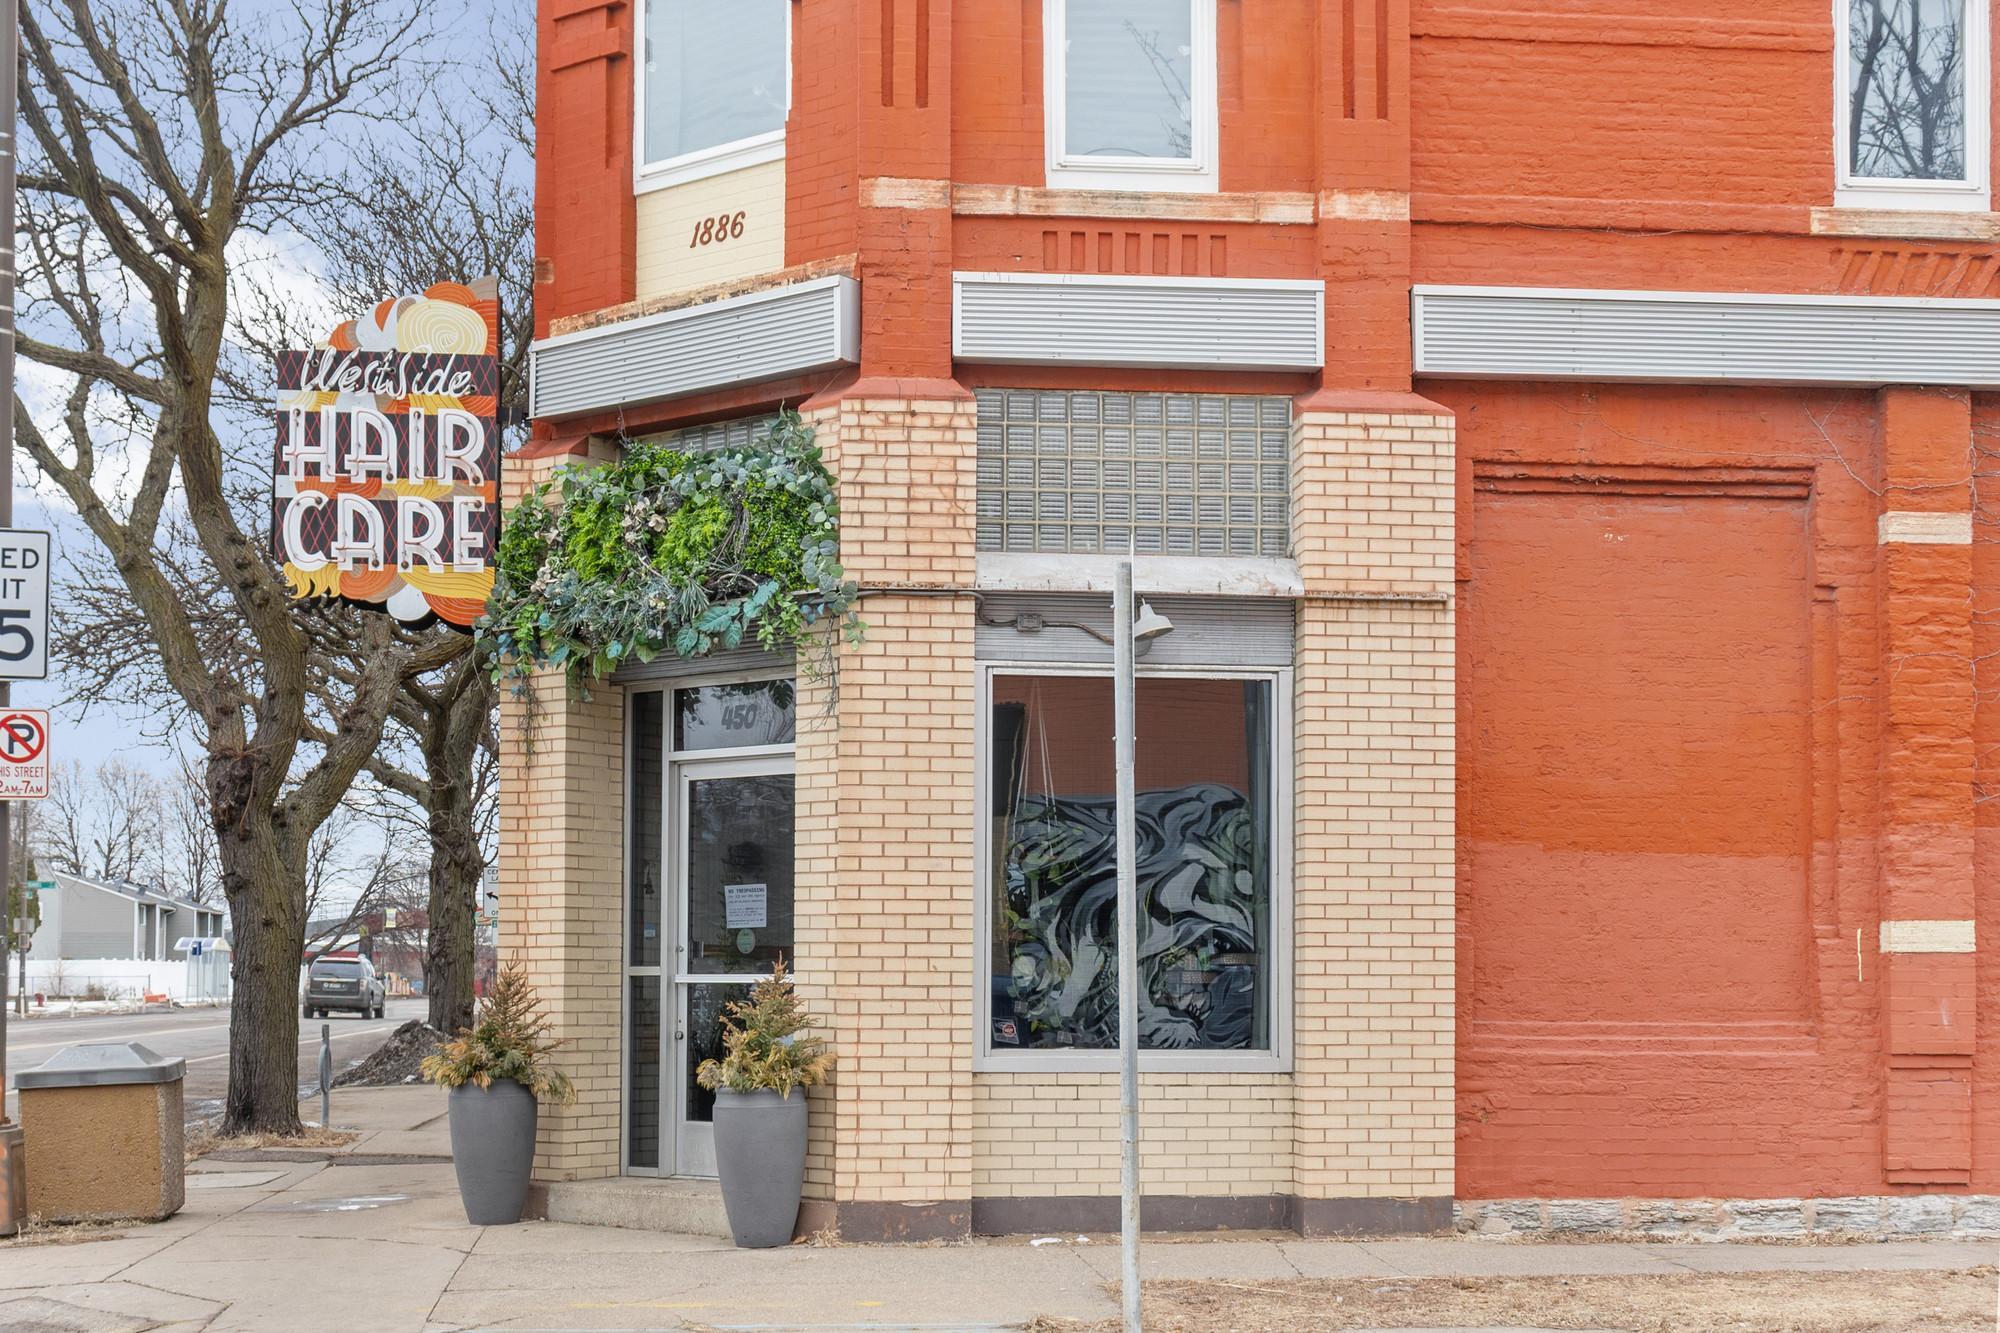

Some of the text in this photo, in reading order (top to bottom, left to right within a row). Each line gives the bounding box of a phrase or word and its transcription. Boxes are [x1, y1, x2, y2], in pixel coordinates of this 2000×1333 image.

[689, 210, 746, 248] 1886
[283, 404, 484, 486] HAIR
[283, 490, 485, 573] CARE
[721, 703, 758, 730] 450
[15, 766, 45, 778] STREET
